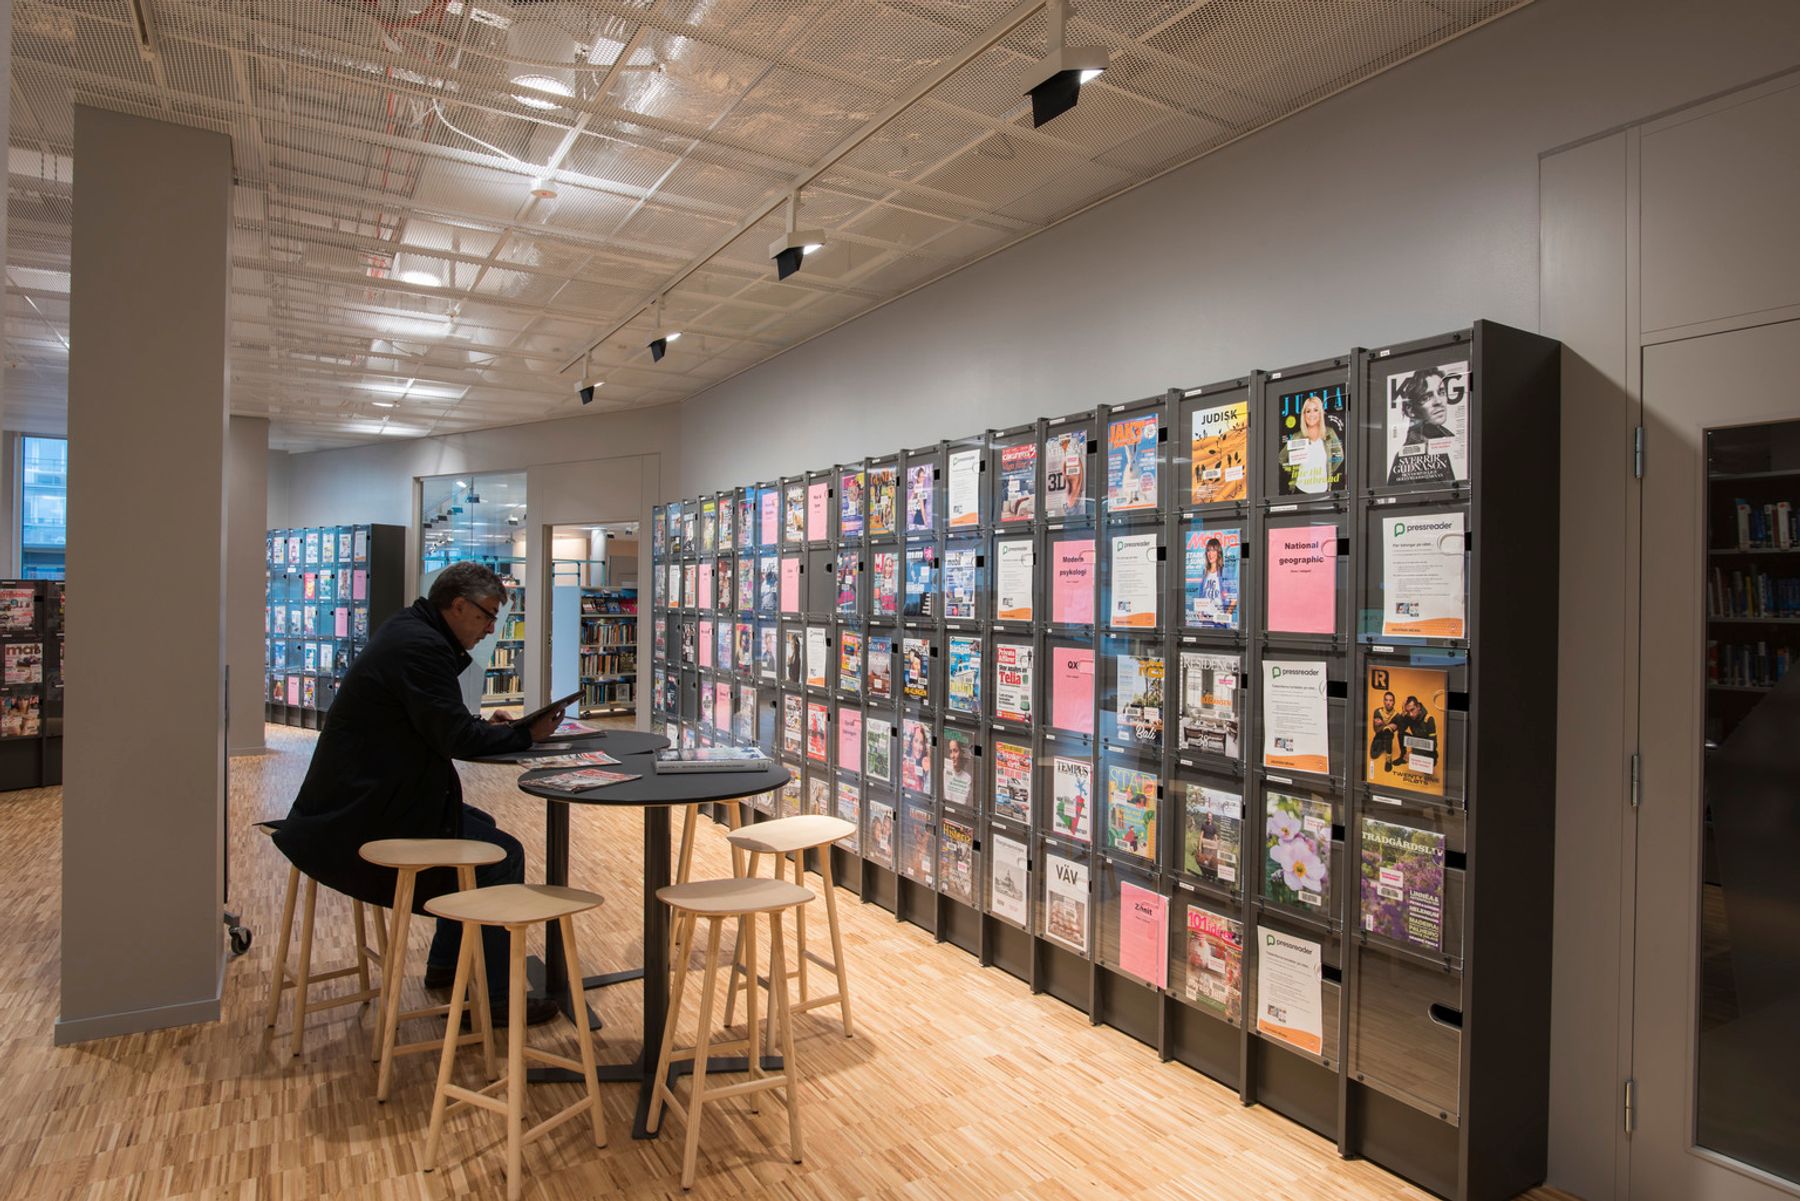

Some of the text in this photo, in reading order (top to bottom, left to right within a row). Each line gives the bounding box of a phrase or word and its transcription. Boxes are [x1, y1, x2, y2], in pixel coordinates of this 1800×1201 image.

[1201, 409, 1238, 425] JUDISK
[1047, 472, 1066, 492] 3D
[1407, 522, 1452, 533] pressreader
[1284, 541, 1319, 550] National
[1279, 556, 1324, 566] geographic
[1059, 568, 1087, 577] psykologi
[1067, 660, 1078, 669] QX
[1183, 658, 1239, 672] RESIDENCE
[999, 671, 1021, 685] Telia
[1282, 668, 1319, 676] pressreader
[1135, 724, 1156, 740] Bali
[1056, 761, 1089, 777] TEMPUS
[1056, 864, 1078, 886] VÄV
[1188, 912, 1206, 932] 101
[1276, 939, 1312, 955] pressreader
